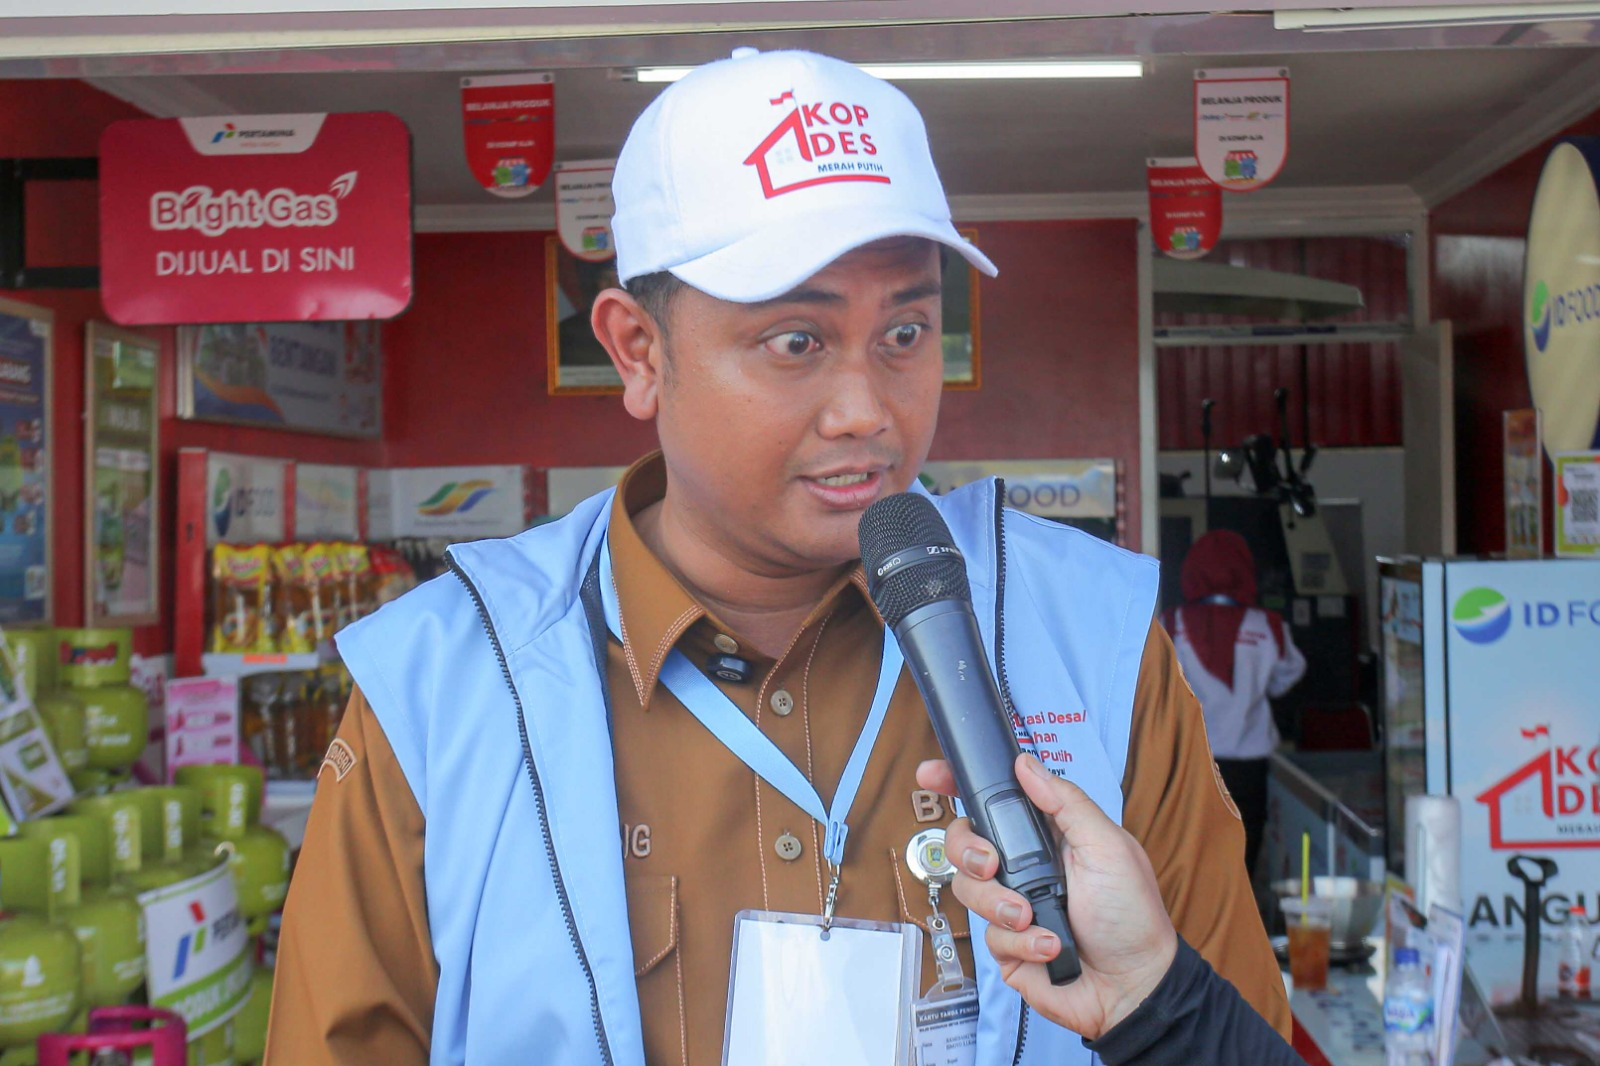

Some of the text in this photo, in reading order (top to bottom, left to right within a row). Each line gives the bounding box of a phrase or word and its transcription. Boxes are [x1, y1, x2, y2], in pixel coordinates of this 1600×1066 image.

[802, 102, 869, 127] KOP
[809, 131, 877, 157] DES
[817, 163, 884, 173] MERAH PUTIH
[154, 189, 336, 233] Bright Gas
[155, 247, 355, 276] DIJUAL DI SINI
[1040, 749, 1073, 763] Putih
